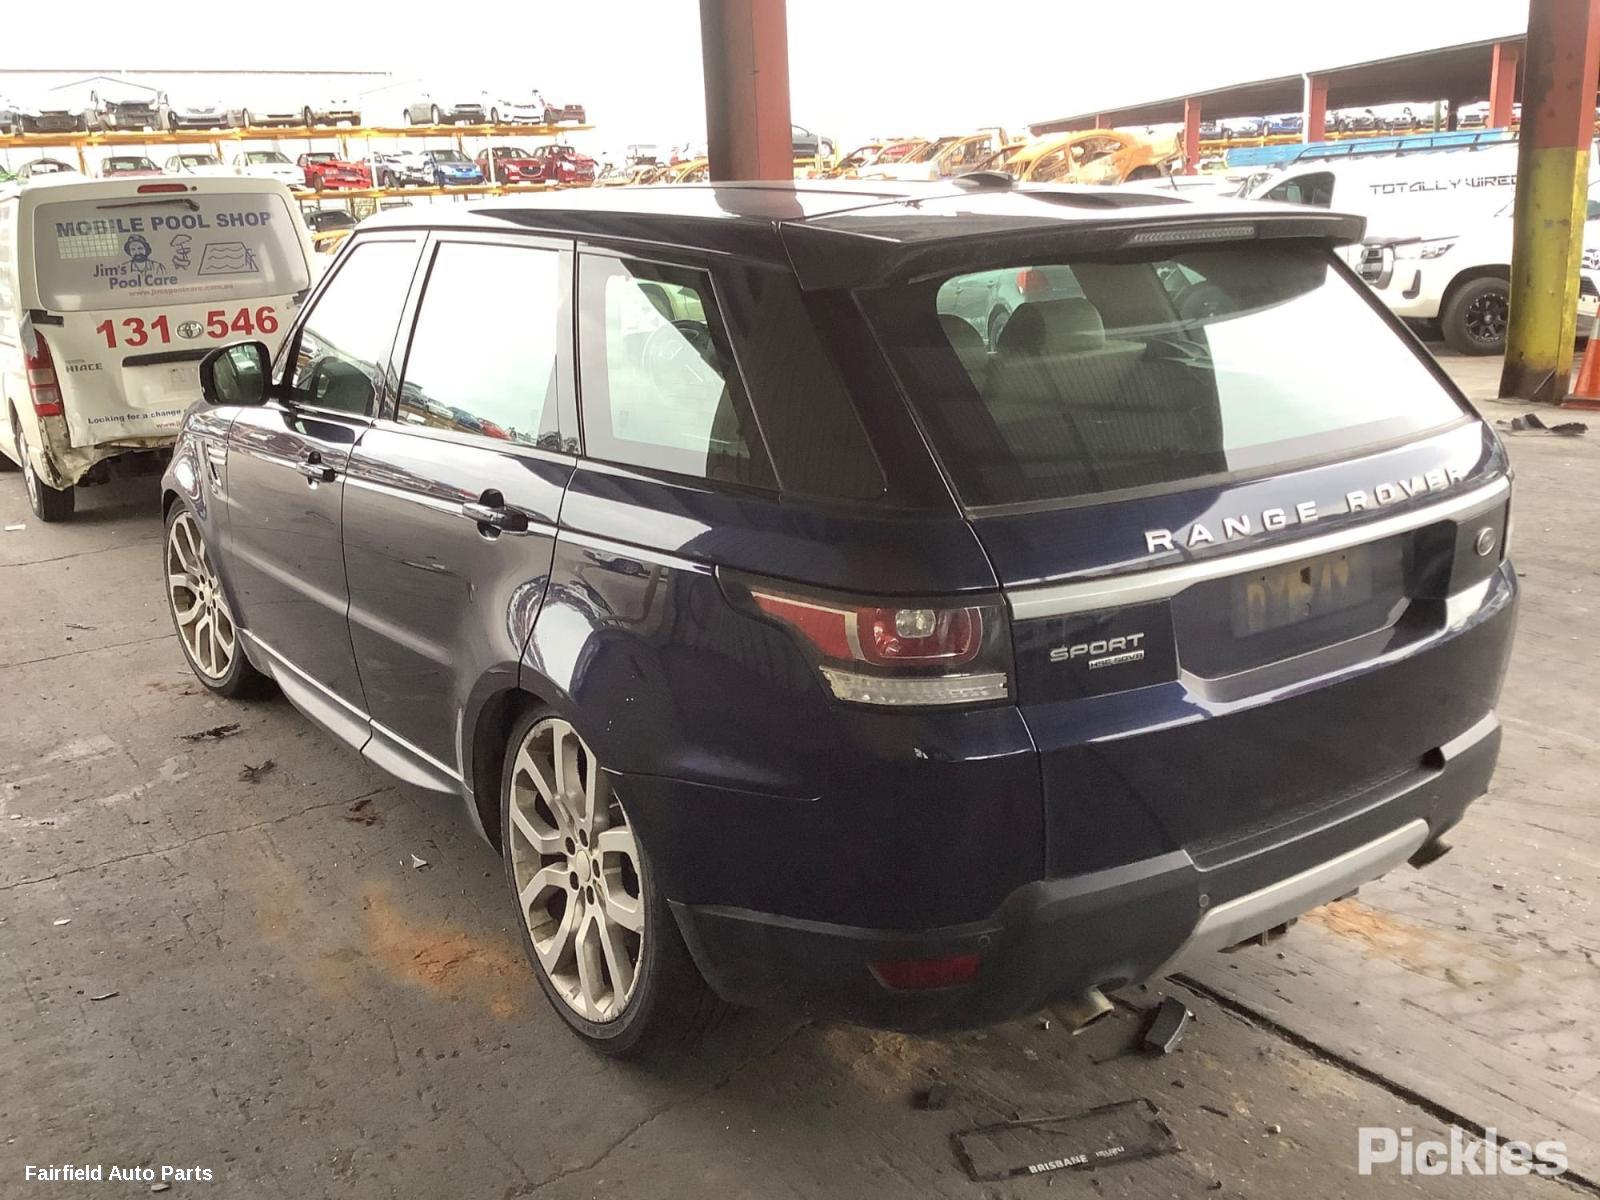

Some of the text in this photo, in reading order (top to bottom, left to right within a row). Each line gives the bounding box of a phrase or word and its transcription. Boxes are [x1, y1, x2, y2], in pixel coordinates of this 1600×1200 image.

[1369, 177, 1461, 195] TOTALLY
[56, 211, 271, 238] MOBILE POOL SHOP
[93, 263, 127, 278] Jim's
[109, 273, 178, 290] Pool Care
[96, 306, 279, 349] 131 546
[65, 362, 103, 373] HIACE
[88, 414, 125, 425] Looking
[127, 413, 140, 421] for
[150, 408, 181, 419] change
[1144, 466, 1468, 554] RANGE ROVER
[1050, 632, 1145, 662] SPORT
[1028, 1154, 1088, 1174] BRISBANE
